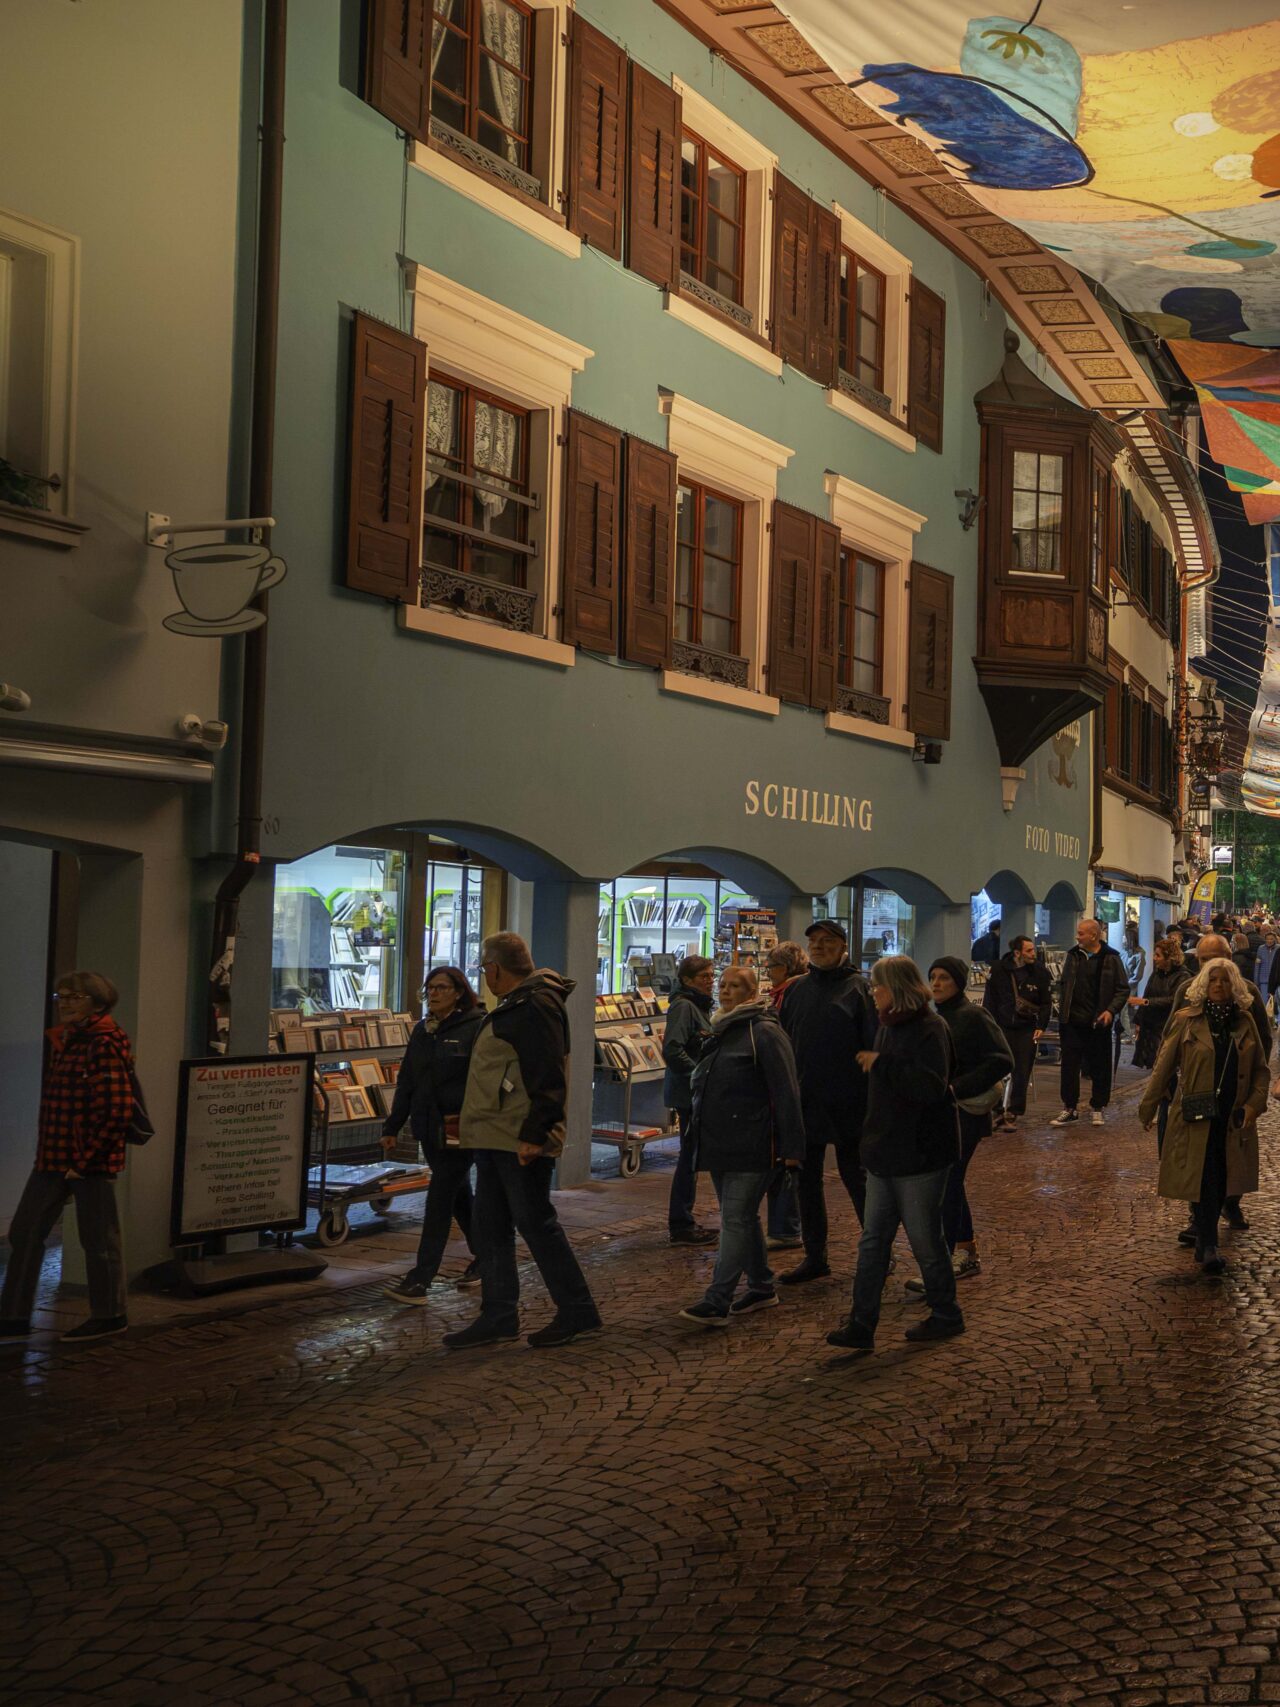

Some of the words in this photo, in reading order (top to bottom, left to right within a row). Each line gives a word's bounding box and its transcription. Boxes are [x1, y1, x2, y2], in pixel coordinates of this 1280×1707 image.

[745, 780, 873, 831] SCHILLING
[1026, 825, 1050, 853] FOTO
[1055, 832, 1080, 860] VIDEO
[196, 1068, 218, 1082] Zu
[221, 1064, 300, 1080] vermieten
[207, 1101, 265, 1115] Geeignet
[268, 1099, 287, 1110] für:
